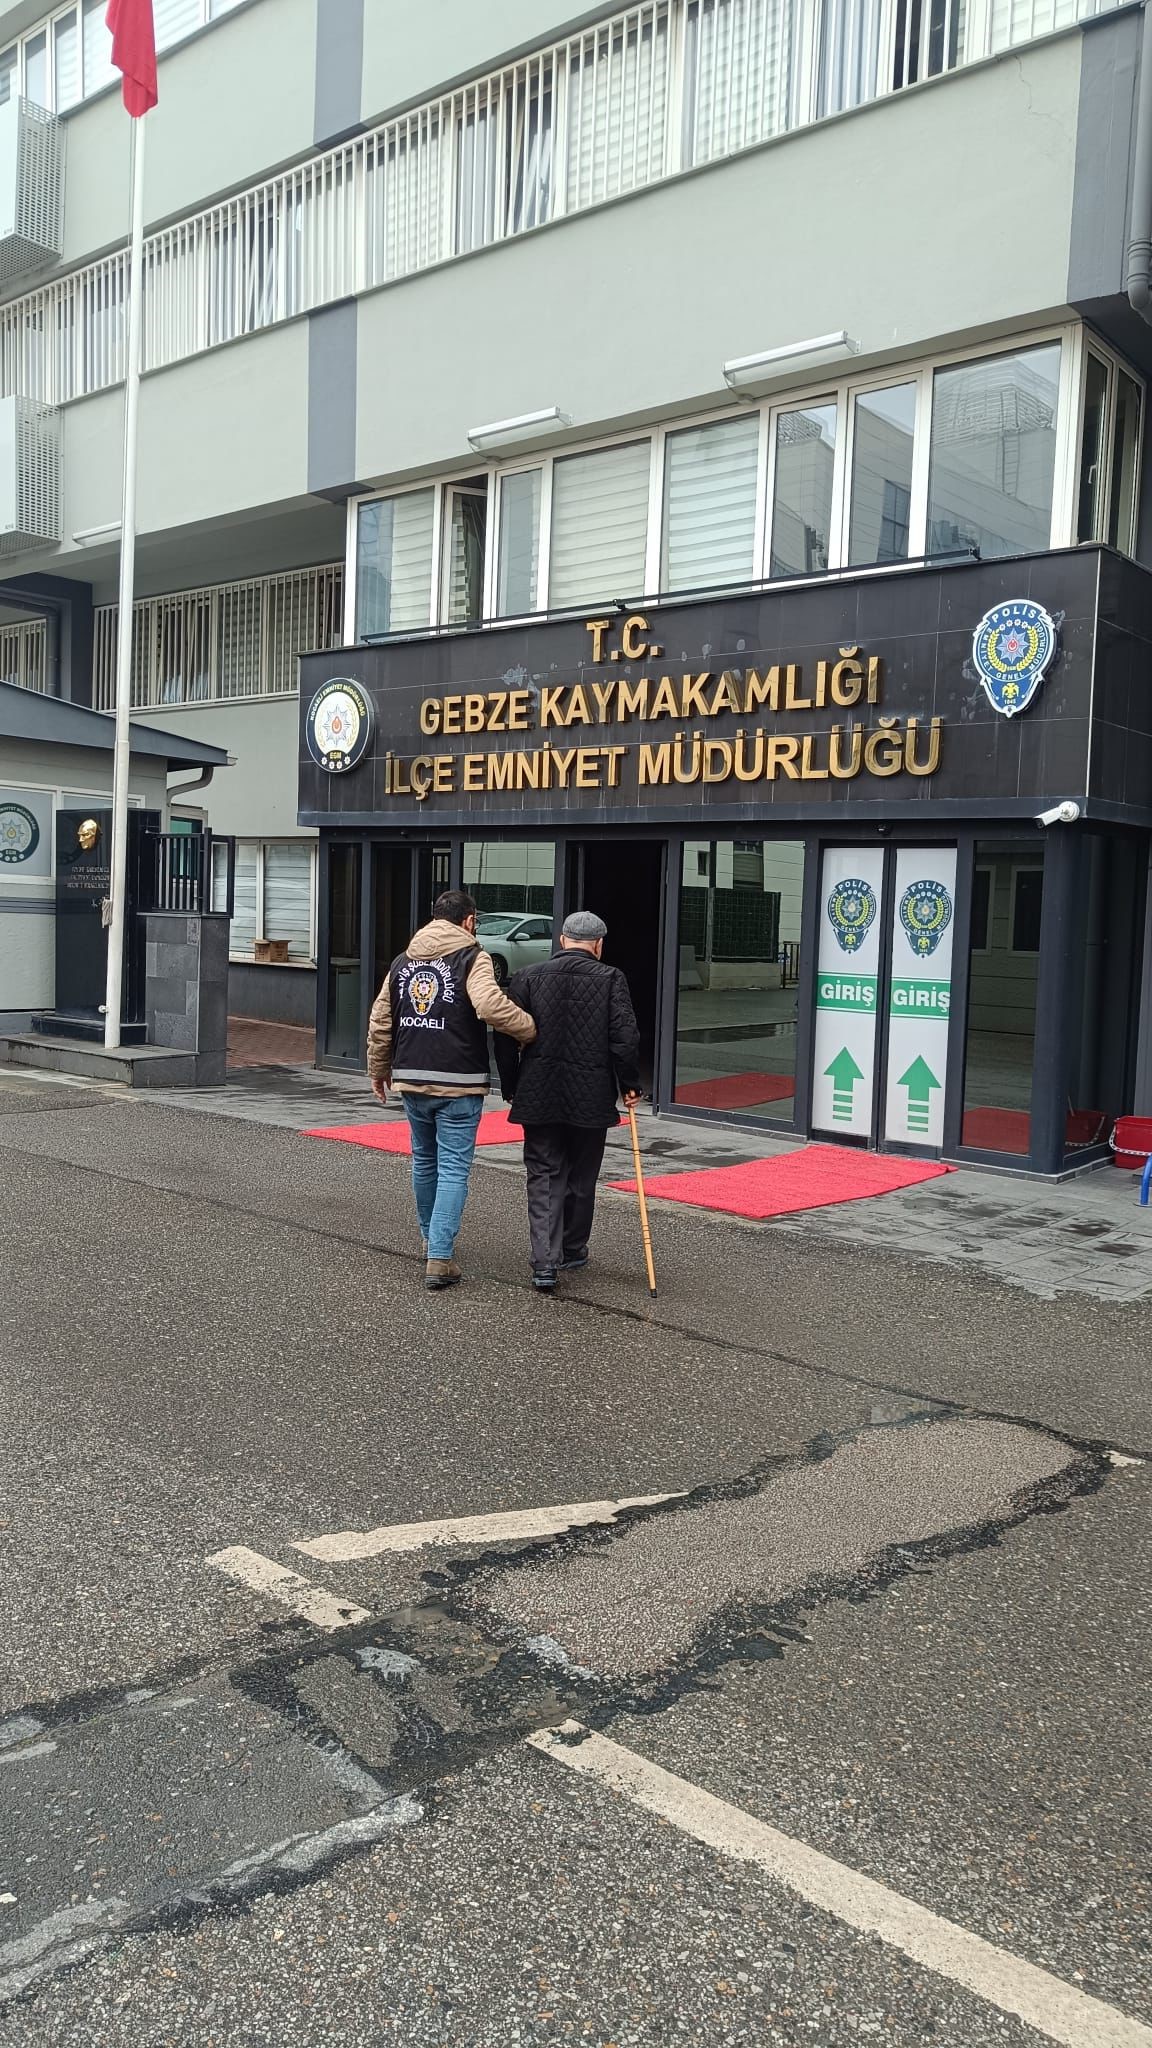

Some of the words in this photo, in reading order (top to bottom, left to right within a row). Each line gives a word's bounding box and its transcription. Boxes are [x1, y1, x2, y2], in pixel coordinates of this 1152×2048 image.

[992, 604, 1037, 623] POLİS
[586, 615, 660, 662] T.C.
[996, 672, 1025, 680] GENEL
[420, 689, 531, 735] GEBZE
[540, 646, 881, 727] KAYMAKAMLIĞI
[385, 752, 455, 801] İLÇE
[463, 741, 626, 791] EMNİYET
[638, 717, 944, 785] MÜDÜRLÜĞÜ
[838, 881, 868, 891] POLİS
[910, 882, 943, 893] POLİS
[820, 980, 874, 1007] GİRİŞ
[893, 985, 951, 1013] GİRİŞ
[399, 1016, 446, 1030] KOCAELİ
